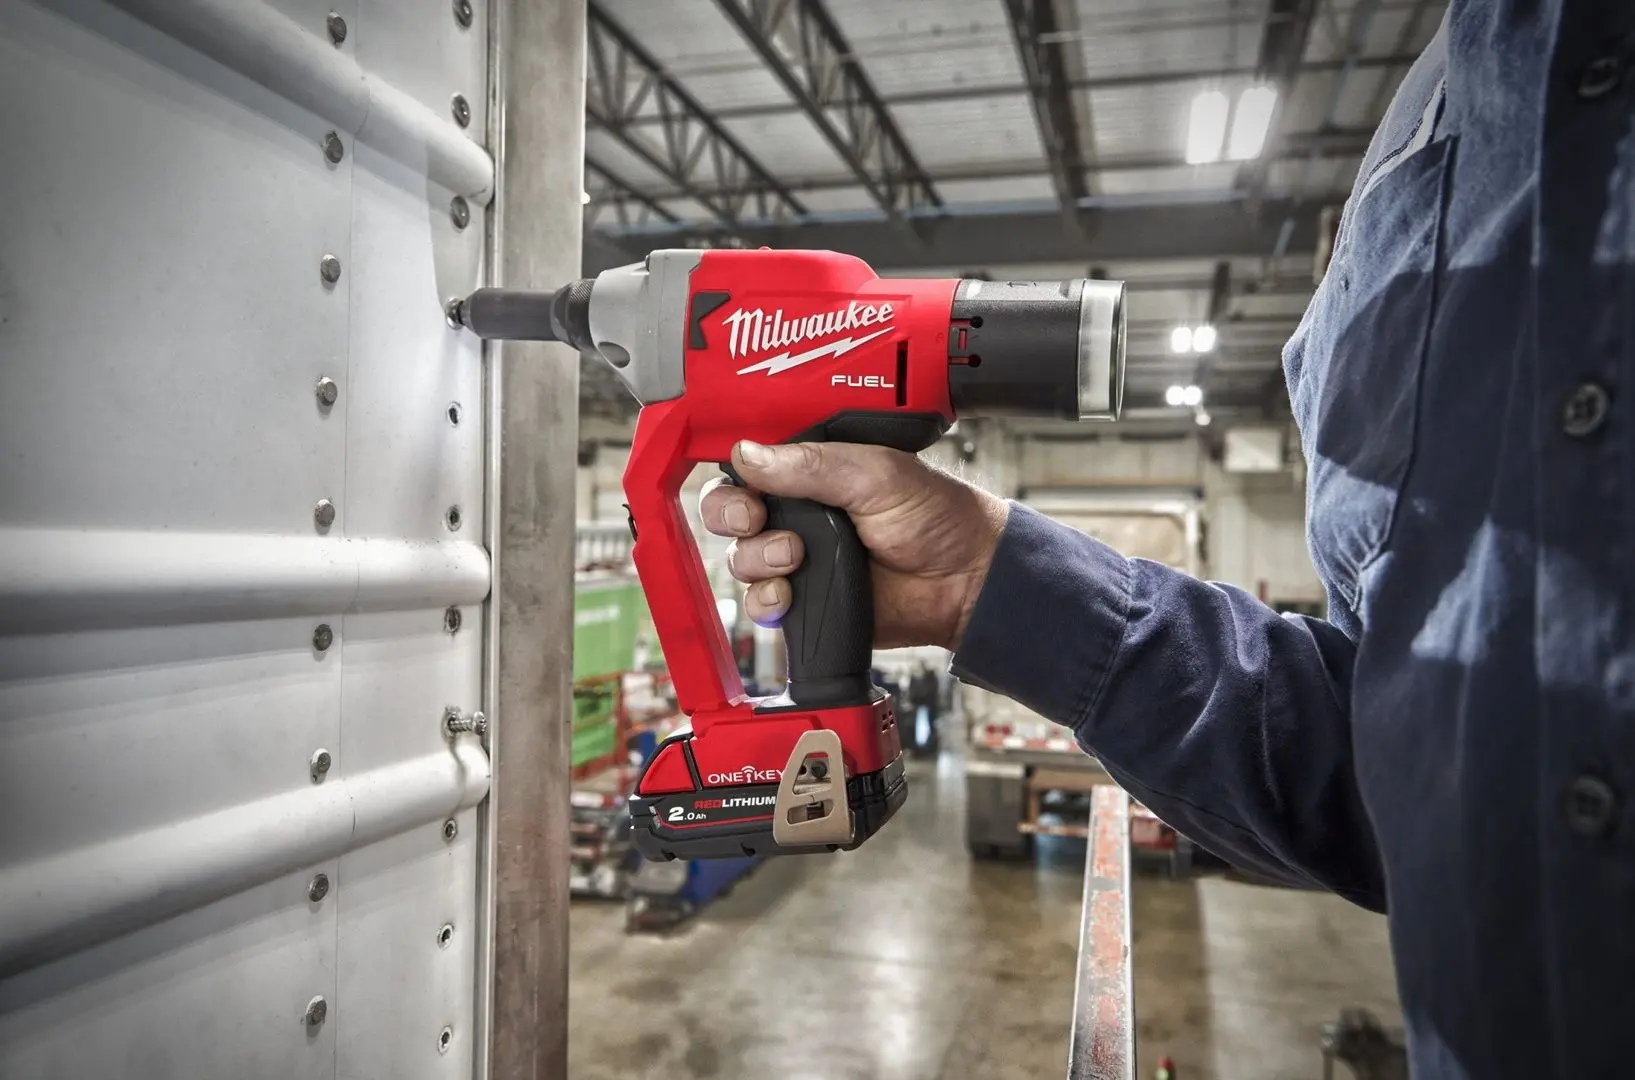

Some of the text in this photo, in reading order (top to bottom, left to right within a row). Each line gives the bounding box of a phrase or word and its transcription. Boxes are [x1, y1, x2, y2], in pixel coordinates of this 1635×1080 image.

[722, 301, 896, 360] Milwaukee
[831, 375, 895, 388] FUEL
[707, 769, 785, 784] ONE KEY
